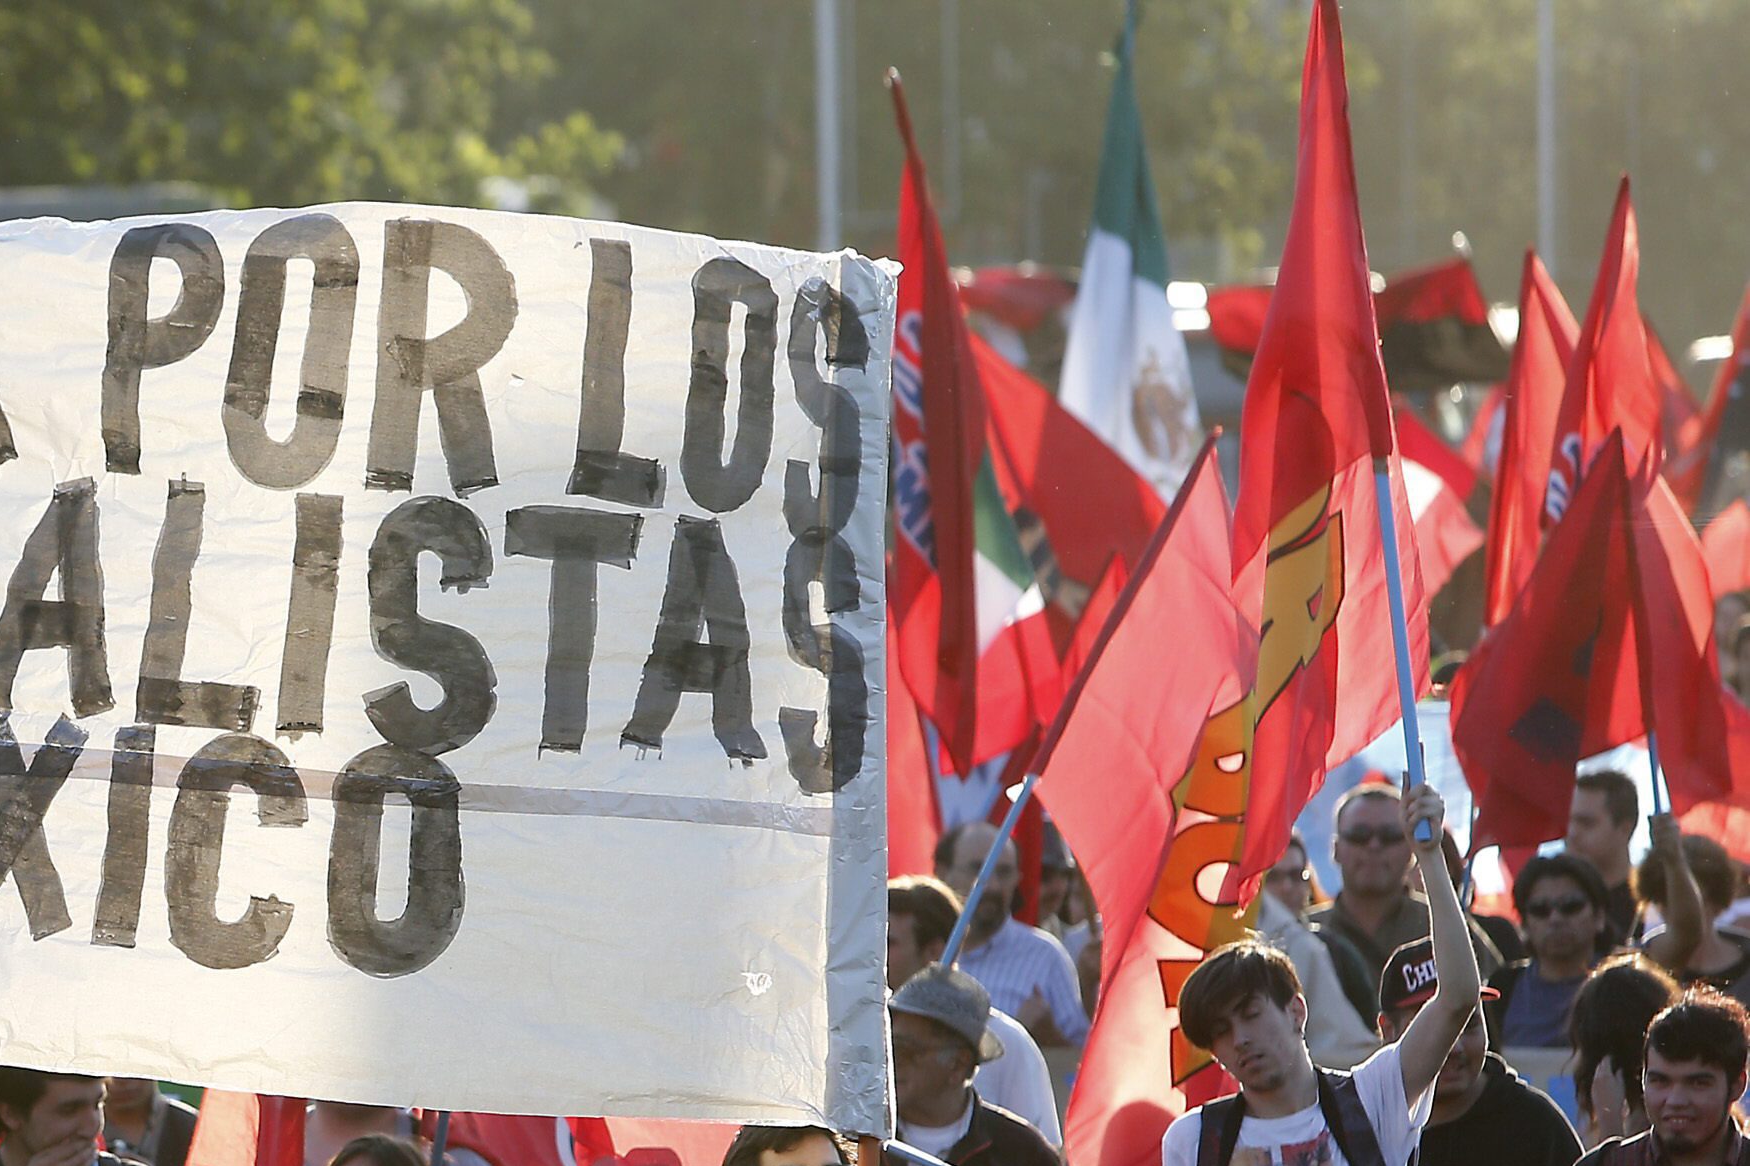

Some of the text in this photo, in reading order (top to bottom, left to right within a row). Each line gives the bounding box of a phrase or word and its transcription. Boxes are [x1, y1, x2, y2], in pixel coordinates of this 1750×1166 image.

[102, 213, 519, 498] POR
[565, 238, 871, 537] LOS
[1402, 958, 1439, 992] CHI
